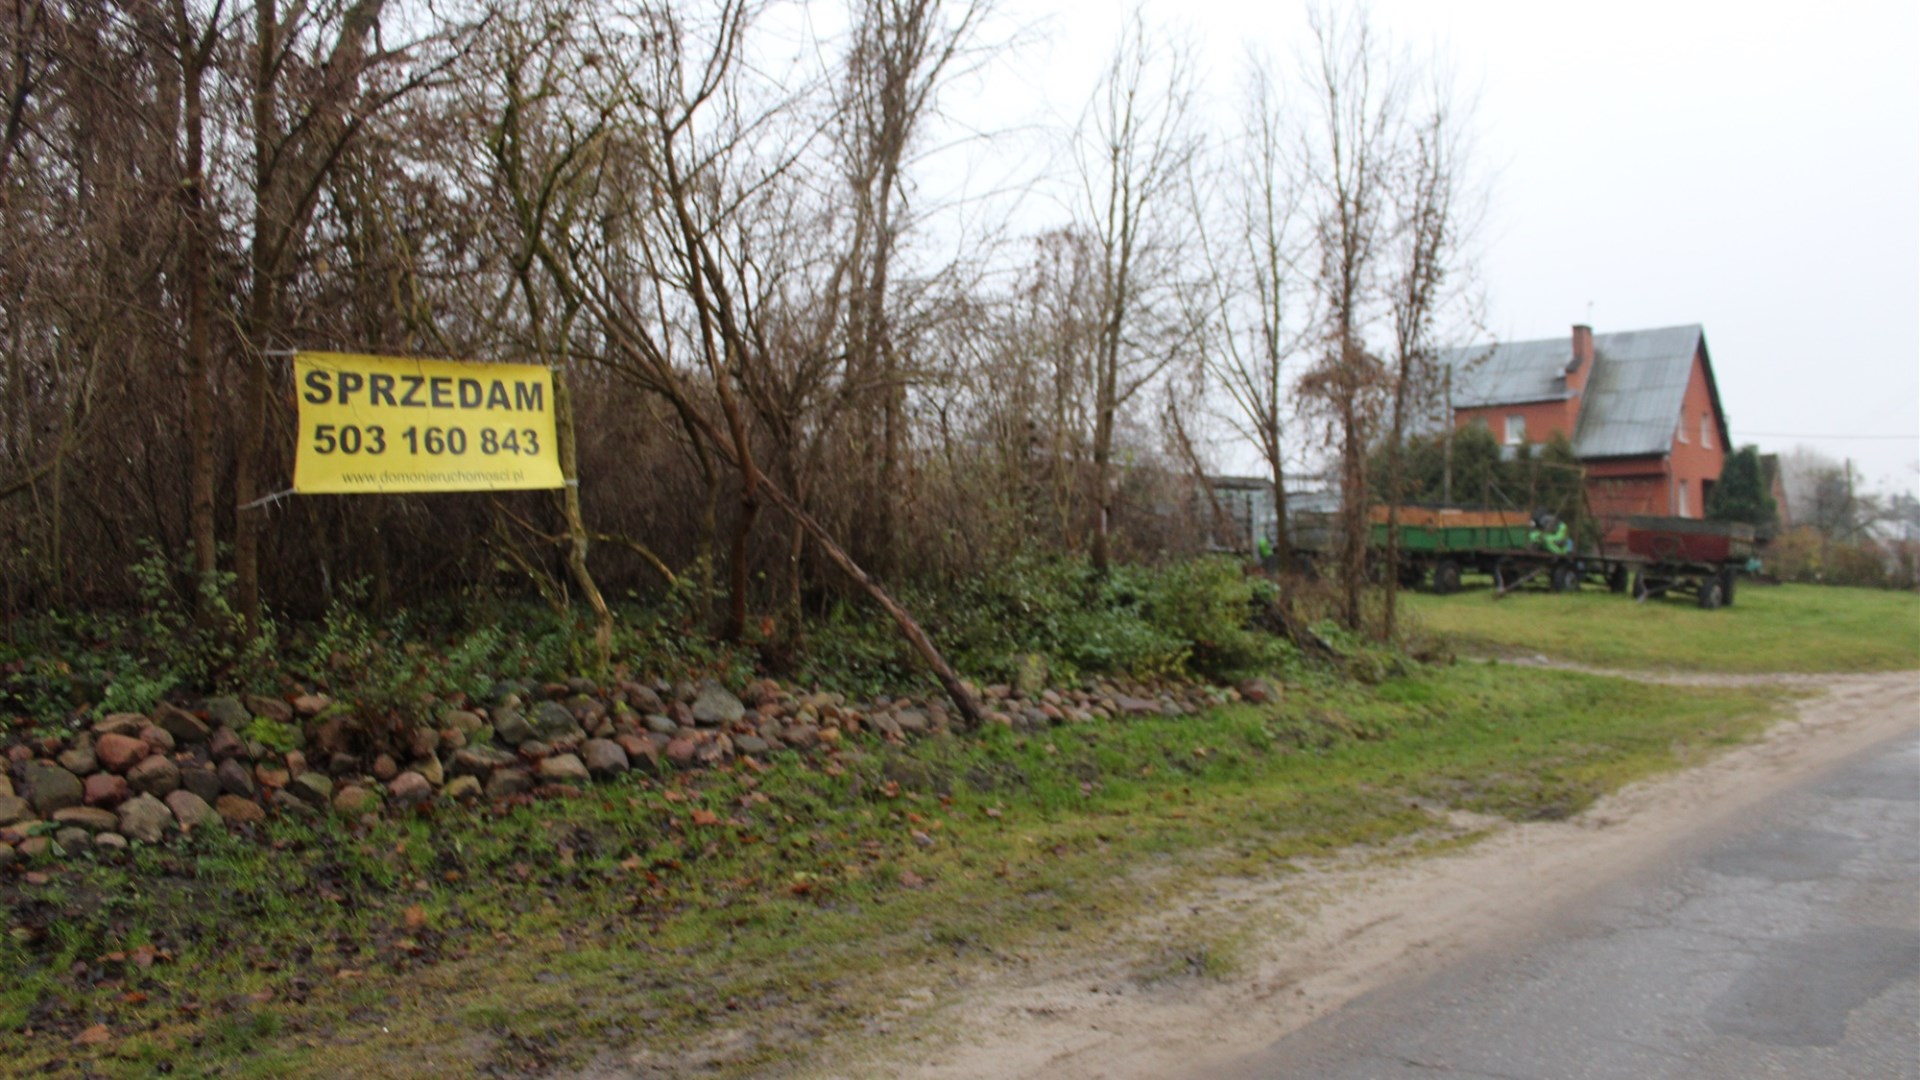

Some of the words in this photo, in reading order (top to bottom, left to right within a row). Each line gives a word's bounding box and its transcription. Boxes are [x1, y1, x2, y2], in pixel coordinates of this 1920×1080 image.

[303, 370, 544, 411] SPRZEDAM
[313, 425, 387, 455] 503
[402, 426, 467, 455] 160
[480, 428, 540, 456] 843
[342, 469, 525, 485] www.domonieruchomosci.pl
